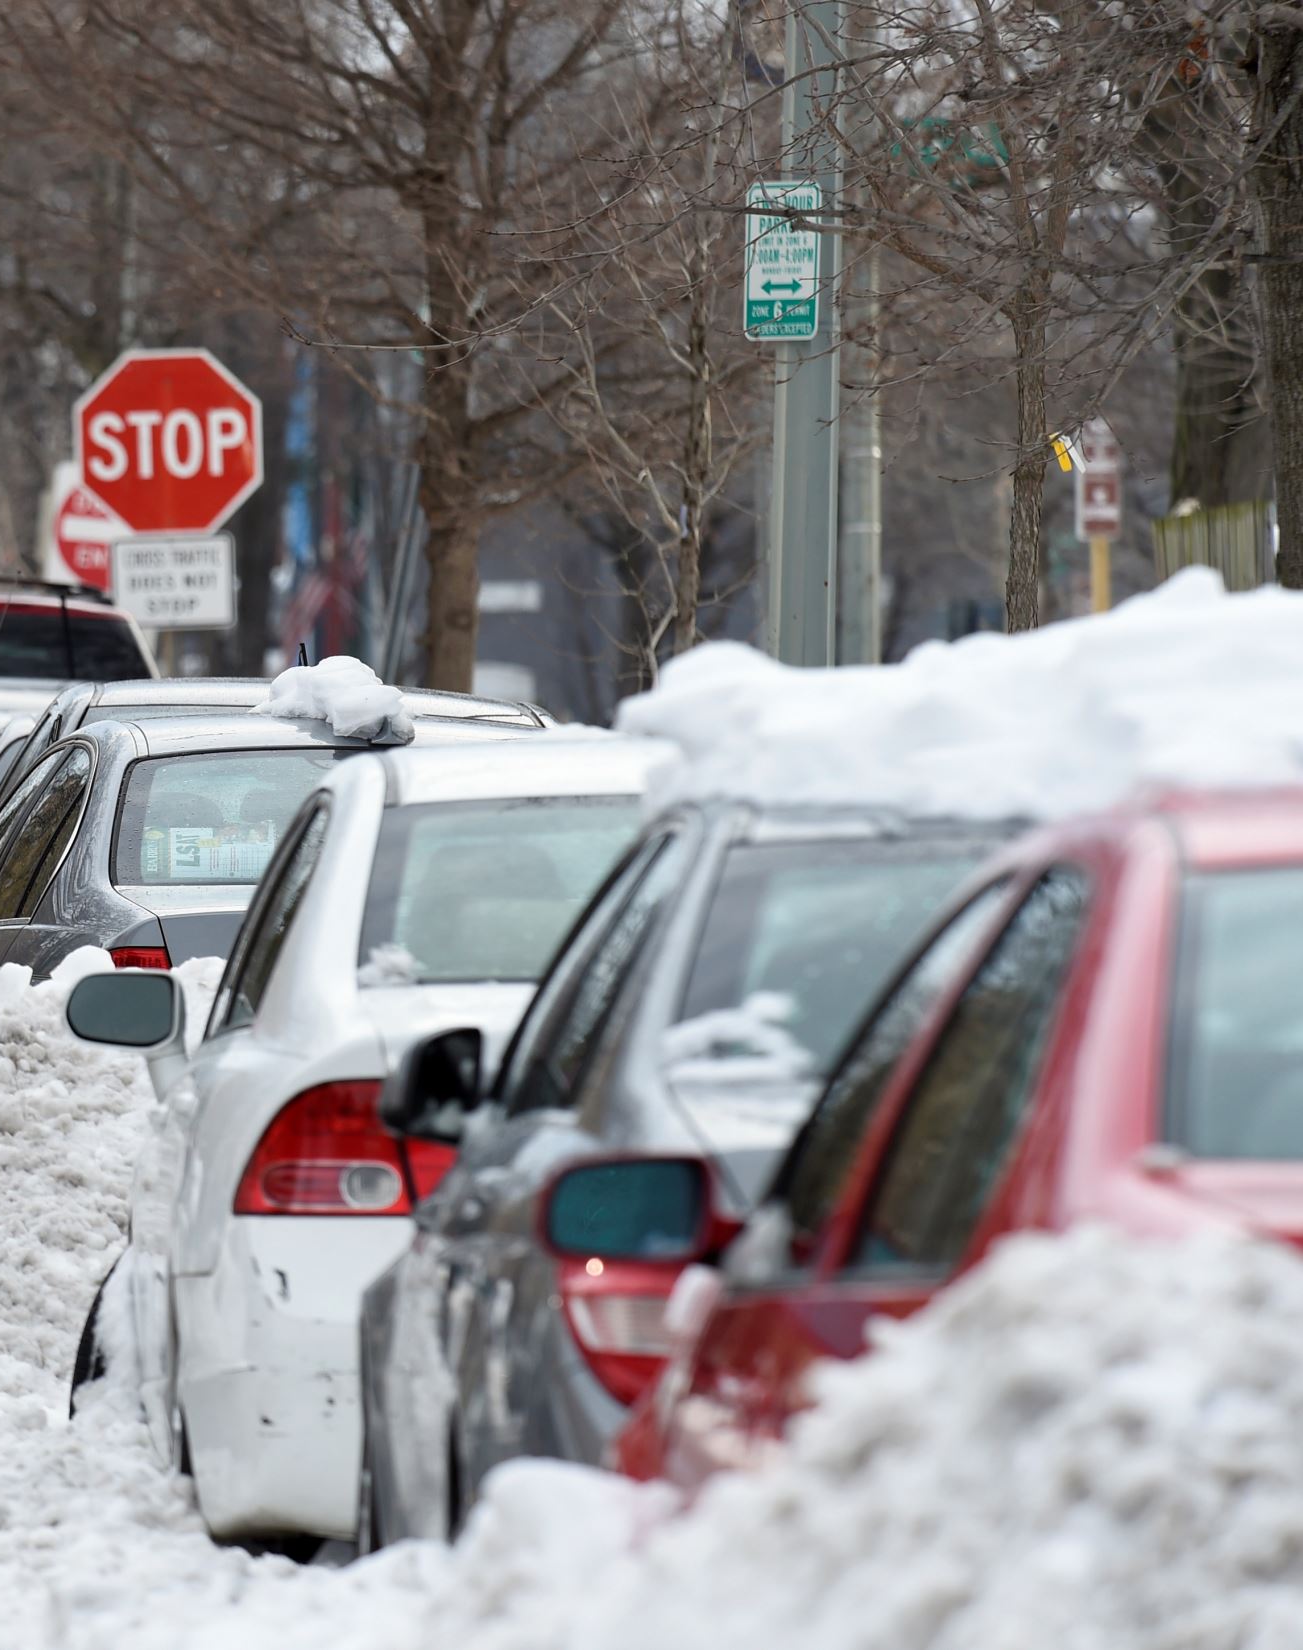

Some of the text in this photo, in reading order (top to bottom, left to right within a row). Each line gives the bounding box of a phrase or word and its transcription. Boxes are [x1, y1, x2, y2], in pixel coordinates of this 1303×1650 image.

[751, 300, 810, 321] ZONE 6 PERMIT
[88, 408, 246, 482] STOP
[126, 550, 165, 569] CROSS
[172, 547, 222, 568] TRAFFIC
[127, 573, 218, 591] DOES NOT
[147, 598, 198, 615] STOP
[175, 833, 201, 867] LSAT
